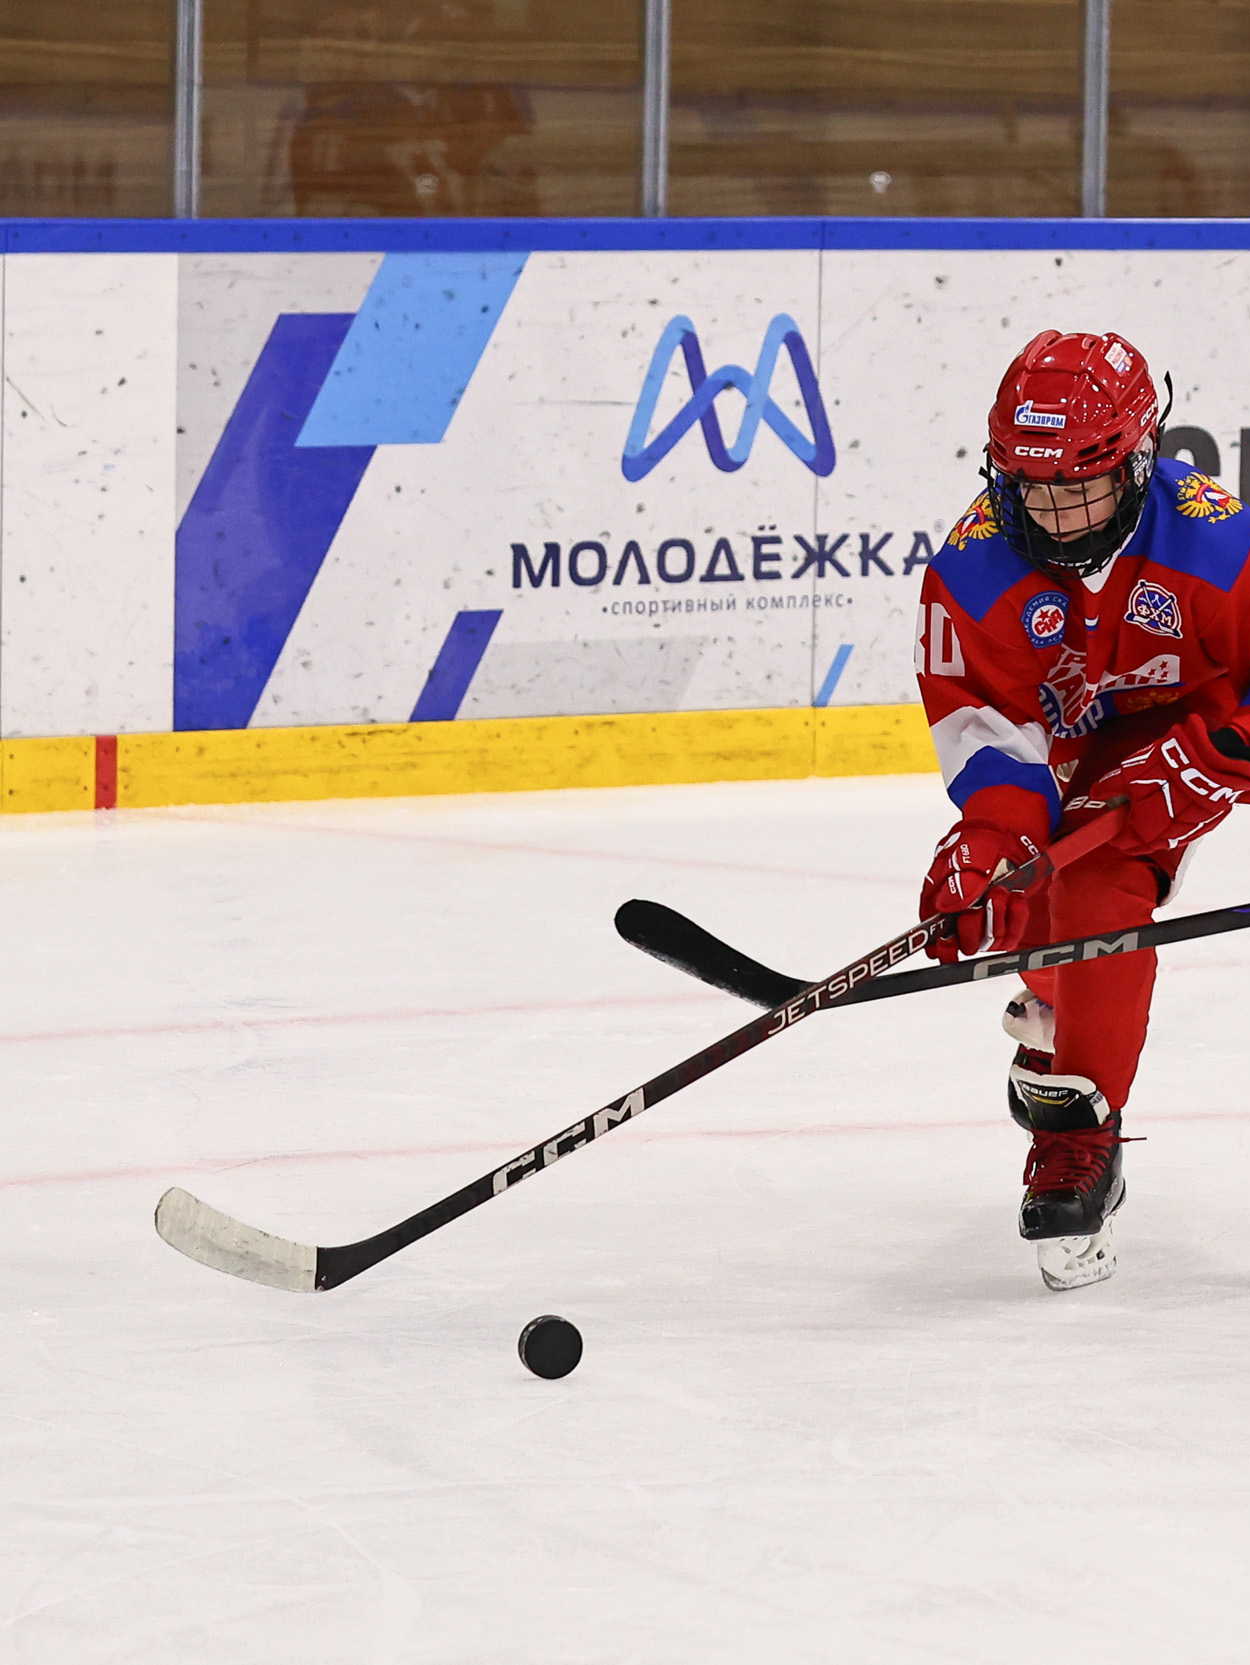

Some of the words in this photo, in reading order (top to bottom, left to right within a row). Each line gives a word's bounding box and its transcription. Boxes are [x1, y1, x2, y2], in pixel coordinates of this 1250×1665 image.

[1015, 446, 1063, 458] CCM
[510, 524, 935, 588] МОЛОДЁЖКА
[611, 594, 737, 617] спортивный
[746, 592, 843, 610] комплекс
[1138, 603, 1173, 627] ФХМ
[1160, 737, 1245, 805] CCM
[768, 929, 929, 1035] JETSPEED
[930, 918, 946, 936] FT
[972, 931, 1139, 981] CCM
[492, 1087, 646, 1196] CCM
